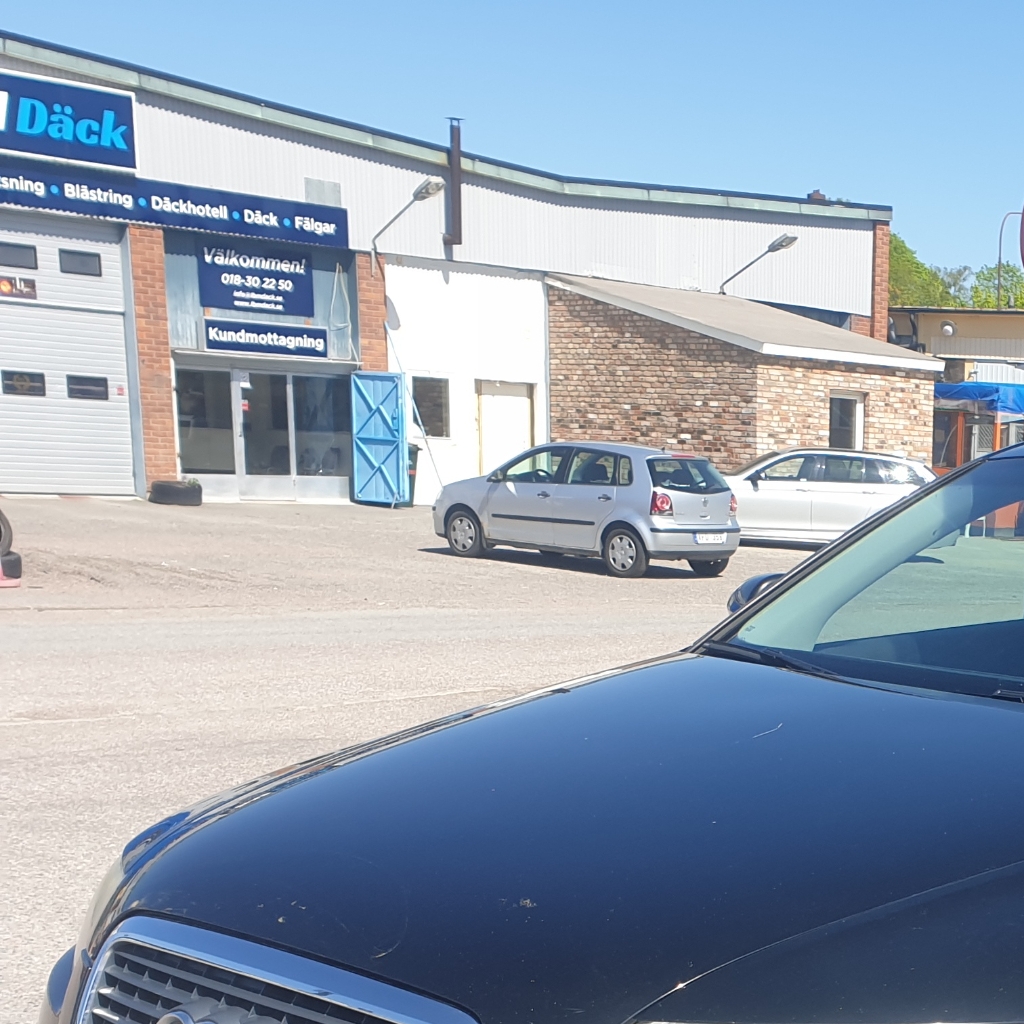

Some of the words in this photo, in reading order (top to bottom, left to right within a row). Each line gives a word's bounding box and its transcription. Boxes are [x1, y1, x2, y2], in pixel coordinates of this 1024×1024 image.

[16, 97, 129, 151] Däck
[0, 175, 43, 197] sning
[151, 195, 228, 220] Däckhotell
[243, 208, 279, 227] Däck
[294, 215, 337, 235] Fälgar
[203, 247, 306, 274] Välkommen!
[220, 273, 261, 288] 018-30
[261, 278, 276, 289] 22
[277, 279, 293, 291] 50
[208, 326, 325, 351] Kundmottagning
